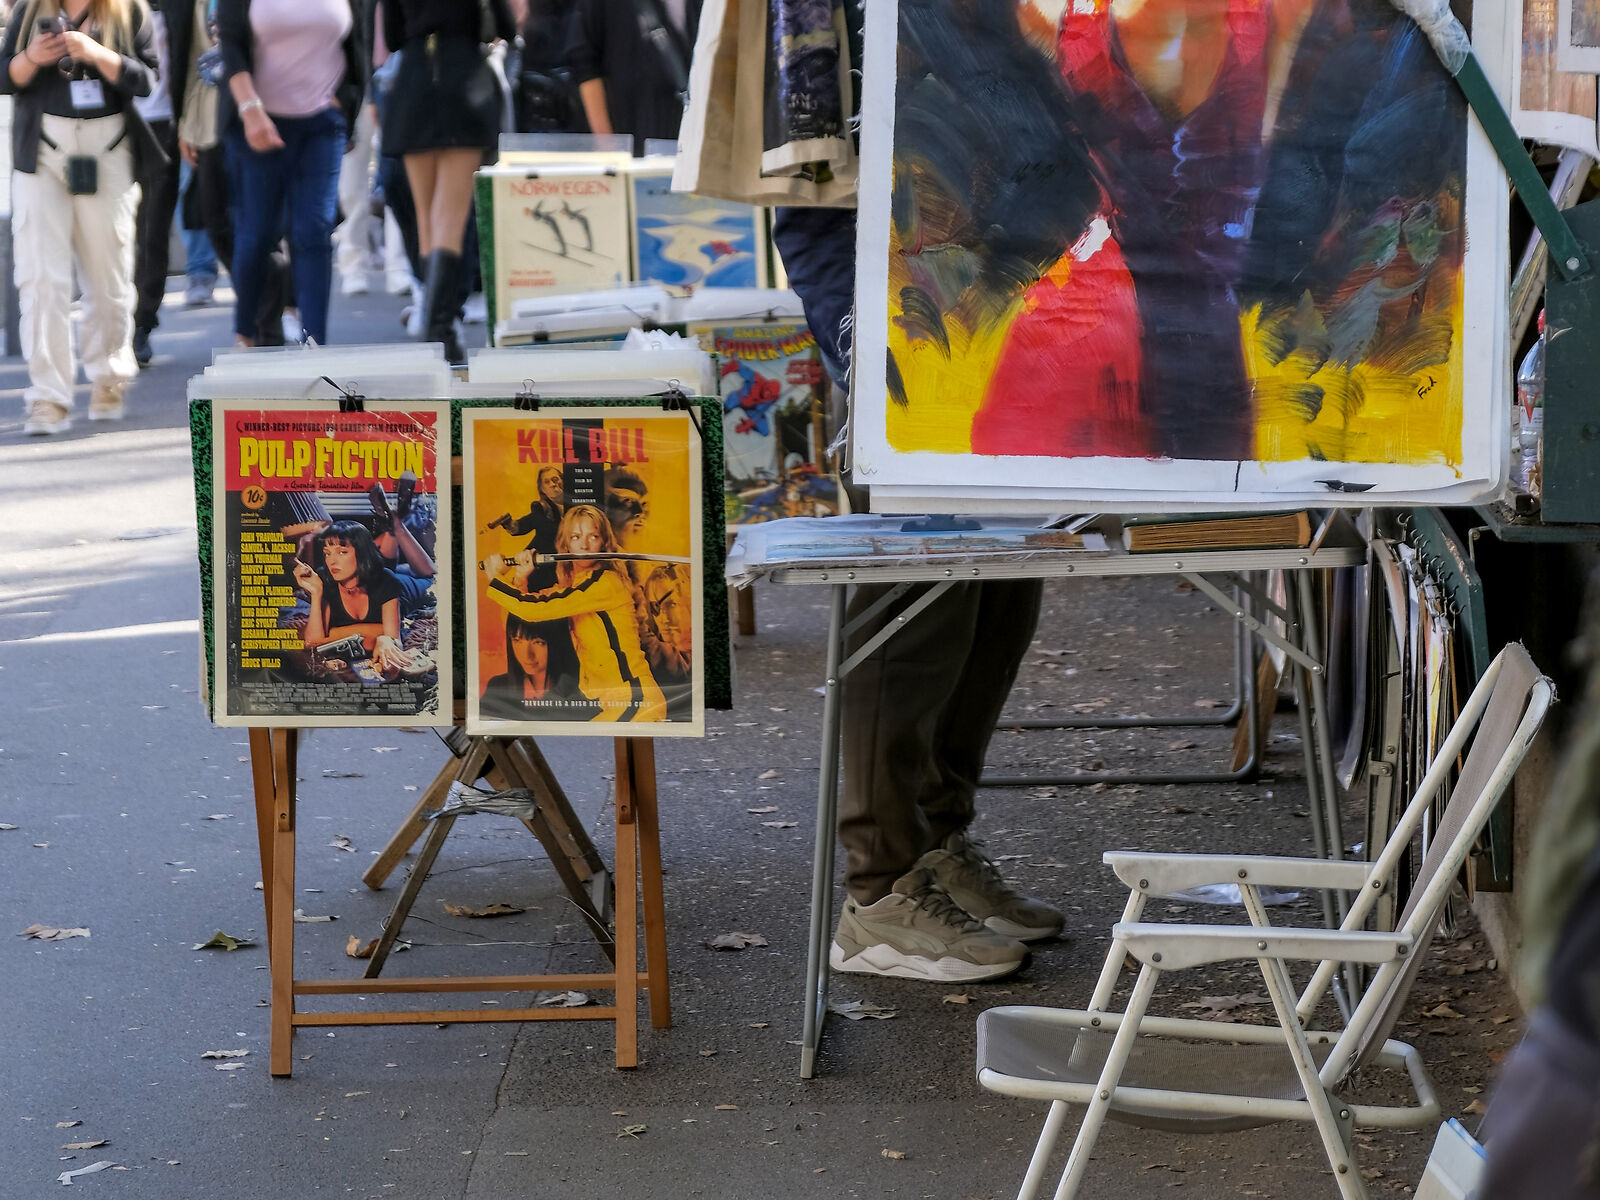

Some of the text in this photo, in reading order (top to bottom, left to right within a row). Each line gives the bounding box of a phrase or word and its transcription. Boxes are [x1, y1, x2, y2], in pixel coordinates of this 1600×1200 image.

[510, 180, 611, 197] NORWEGEN
[733, 325, 797, 339] AMAZING
[239, 437, 424, 480] PULP FICTION
[517, 428, 649, 464] KILL BILL
